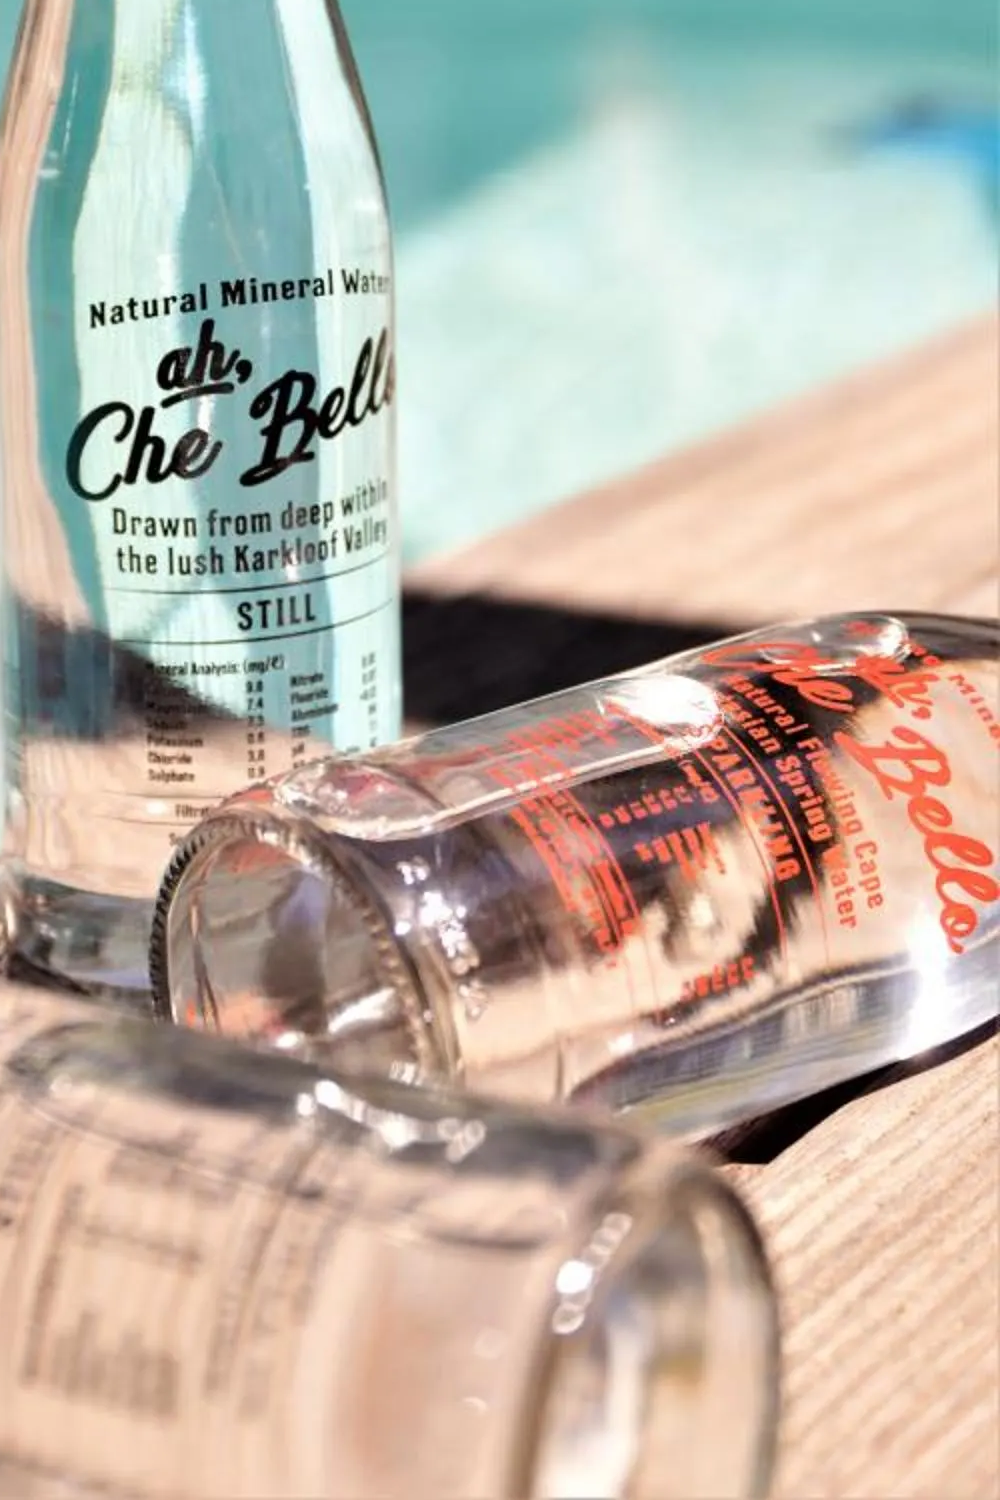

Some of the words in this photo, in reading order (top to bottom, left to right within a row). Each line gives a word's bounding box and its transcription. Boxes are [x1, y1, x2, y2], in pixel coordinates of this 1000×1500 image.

[90, 284, 207, 328] Natural
[221, 269, 334, 307] Mineral
[156, 318, 252, 392] ah,
[66, 401, 223, 501] Che
[112, 507, 197, 538] Drawn
[206, 508, 272, 537] from
[281, 500, 335, 531] deep
[117, 546, 158, 574] the
[168, 547, 225, 576] lush
[235, 528, 338, 573] Karkloof
[237, 593, 317, 632] STILL
[774, 752, 834, 843] Spring
[832, 725, 1000, 955] Bello
[855, 839, 884, 911] Cape
